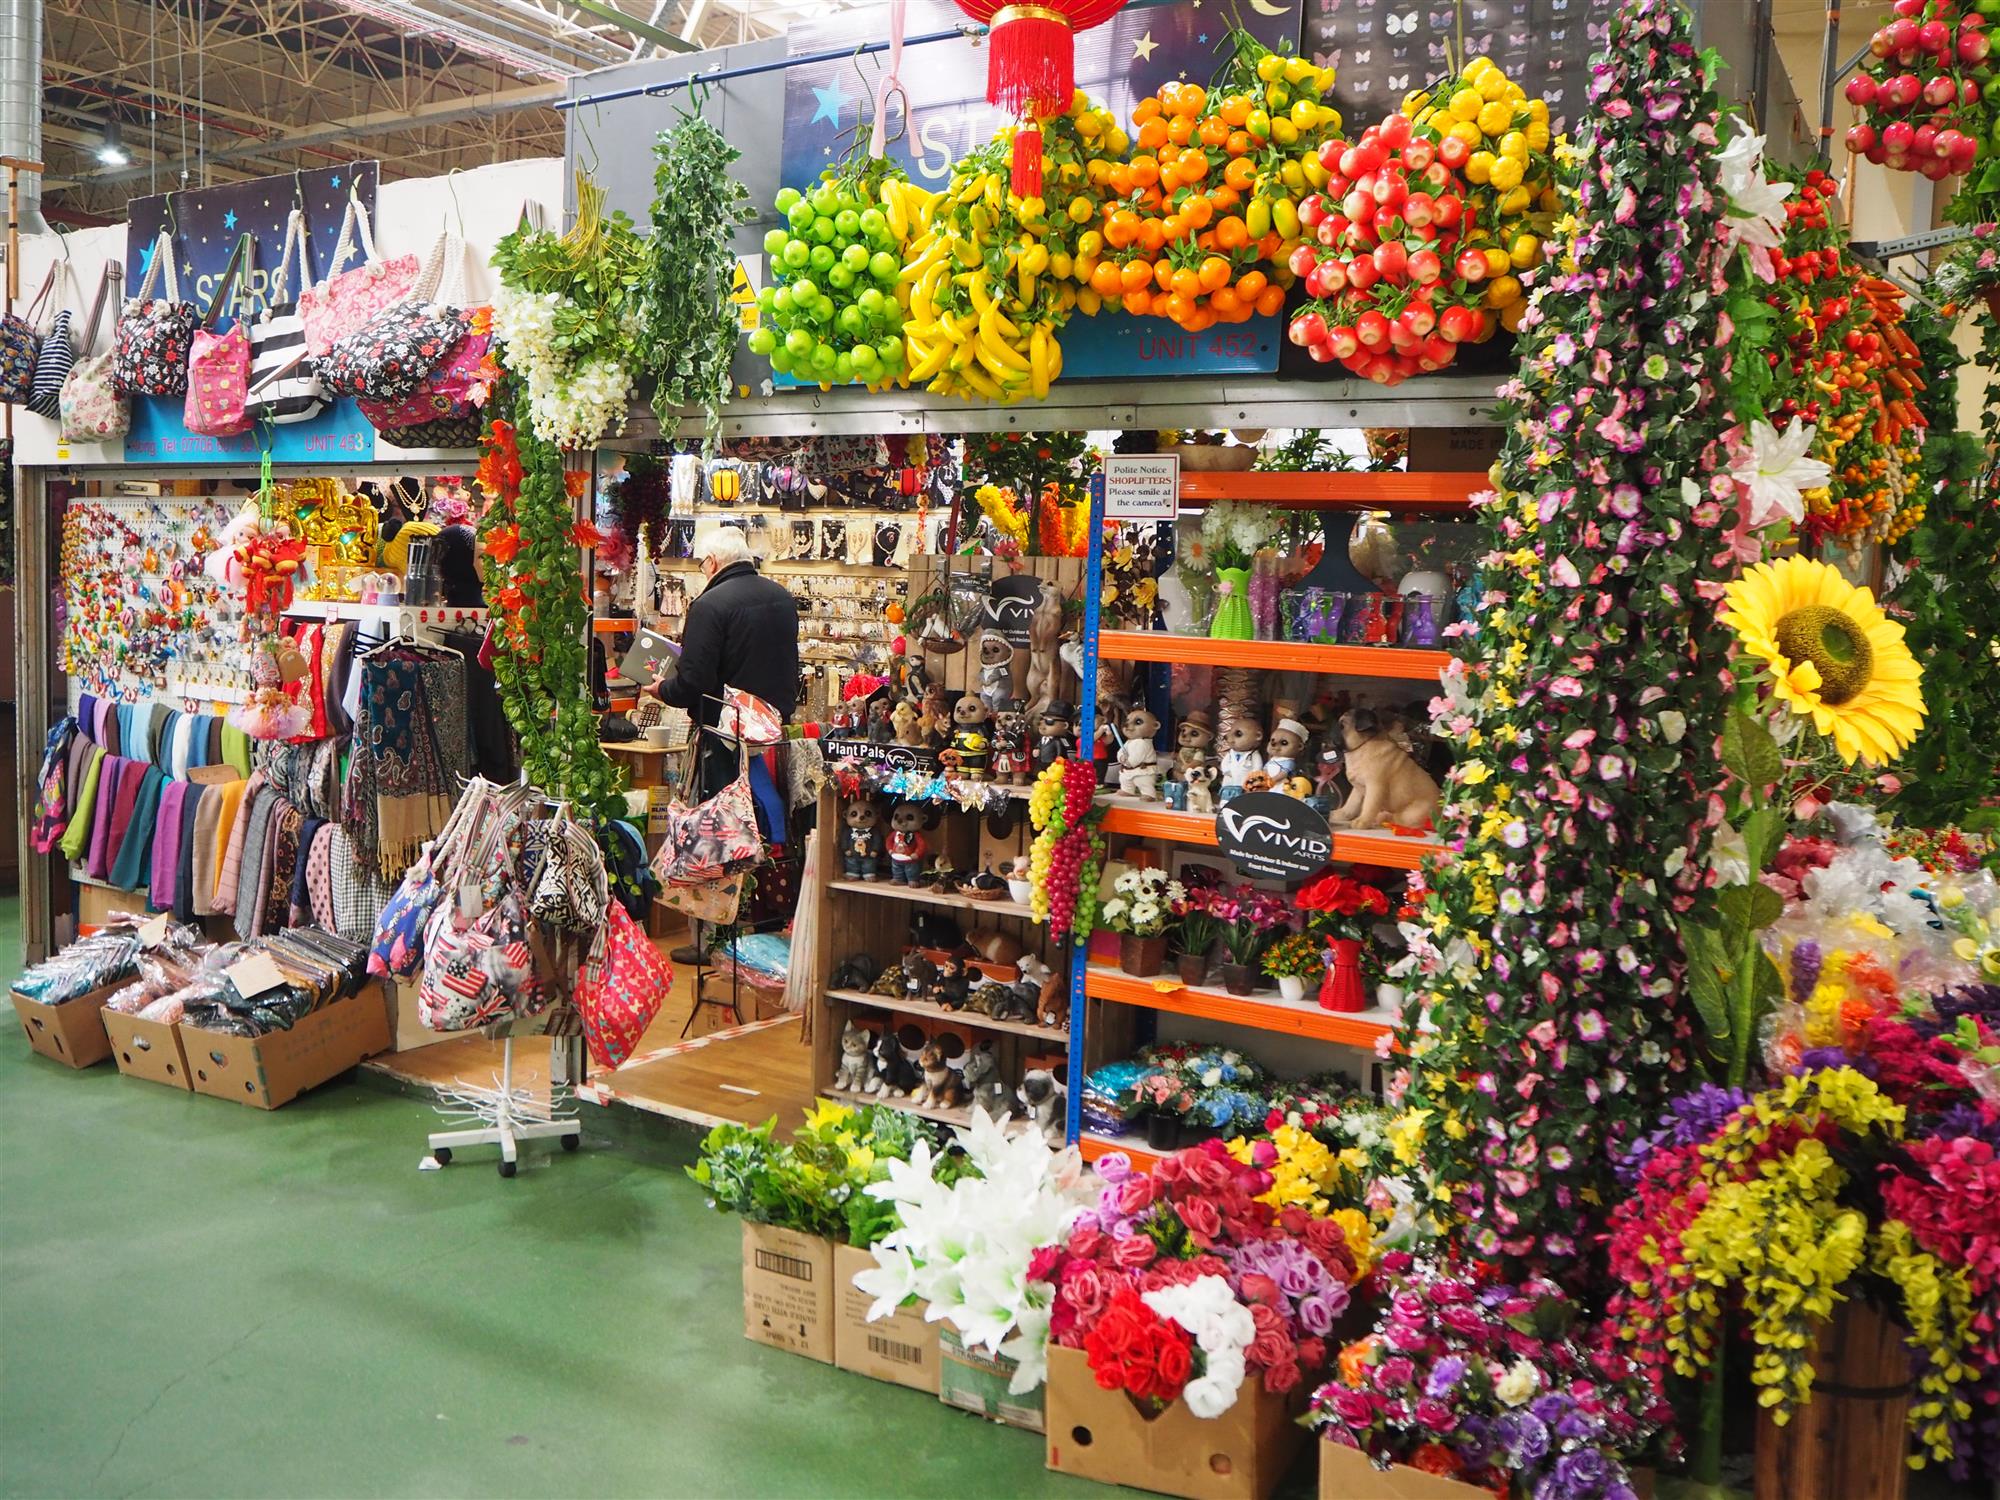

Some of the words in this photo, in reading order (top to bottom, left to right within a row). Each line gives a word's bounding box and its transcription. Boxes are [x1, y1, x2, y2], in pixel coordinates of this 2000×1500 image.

[1138, 334, 1205, 361] UNIT
[1208, 333, 1257, 358] 452
[305, 434, 337, 452] UNIT
[339, 432, 363, 451] 453
[1114, 466, 1138, 474] Polite
[1140, 466, 1167, 474] Notice
[1109, 477, 1172, 485] SHOPLIFTERS
[1109, 488, 1136, 496] Please
[1138, 488, 1160, 496] smile
[1162, 488, 1171, 496] at
[828, 741, 858, 756] Plant
[860, 744, 886, 759] Pals
[1257, 829, 1327, 853] VIVID
[1253, 854, 1276, 864] Outdoor
[1293, 850, 1326, 862] ARTS
